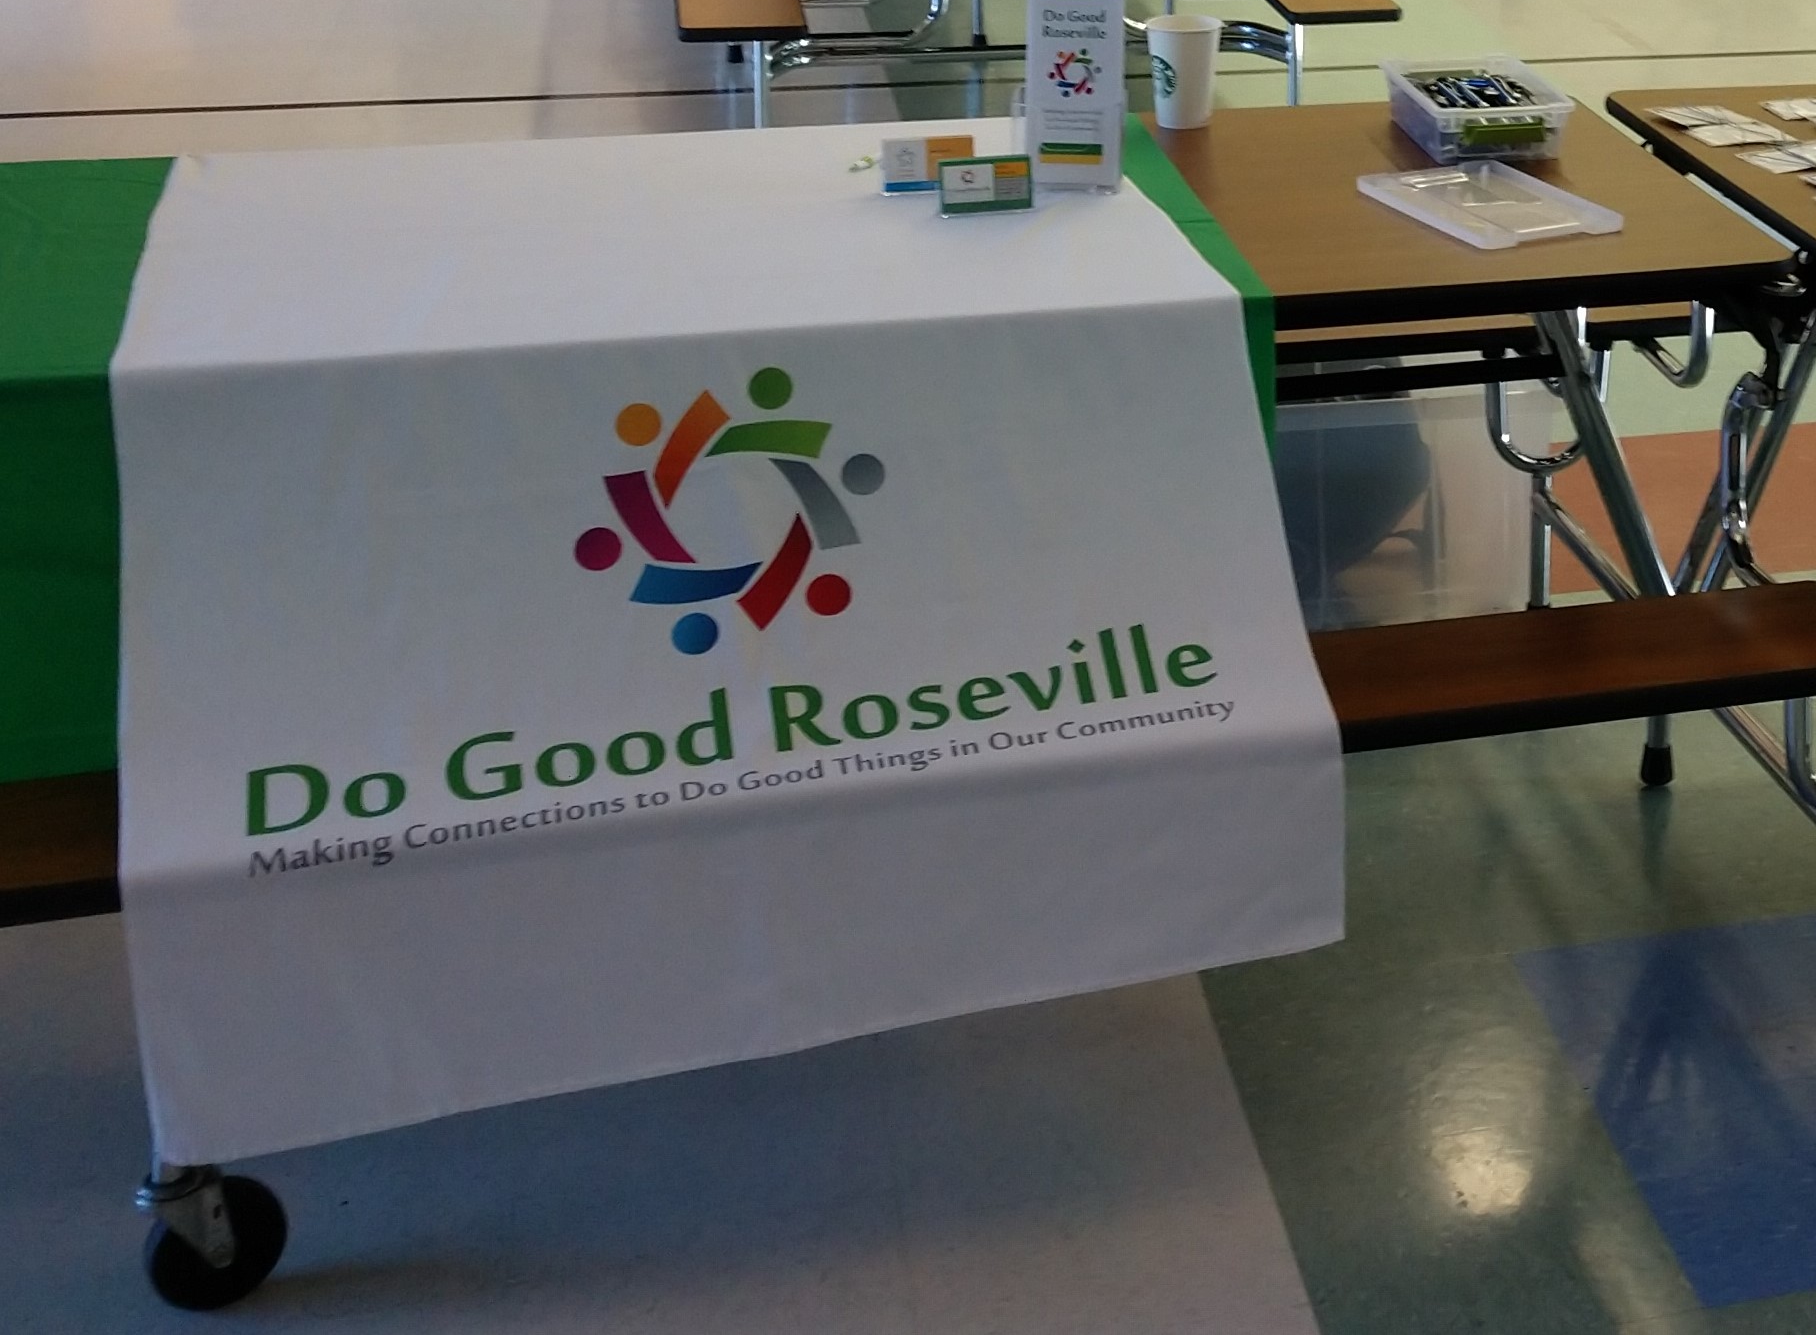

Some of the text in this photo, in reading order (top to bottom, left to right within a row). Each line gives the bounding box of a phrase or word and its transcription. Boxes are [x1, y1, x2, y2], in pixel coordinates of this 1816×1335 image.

[1043, 9, 1107, 23] Do Good
[245, 623, 1218, 836] Do Good Roseville
[248, 698, 1236, 878] Making Connections to Do Good Things in Our Community
